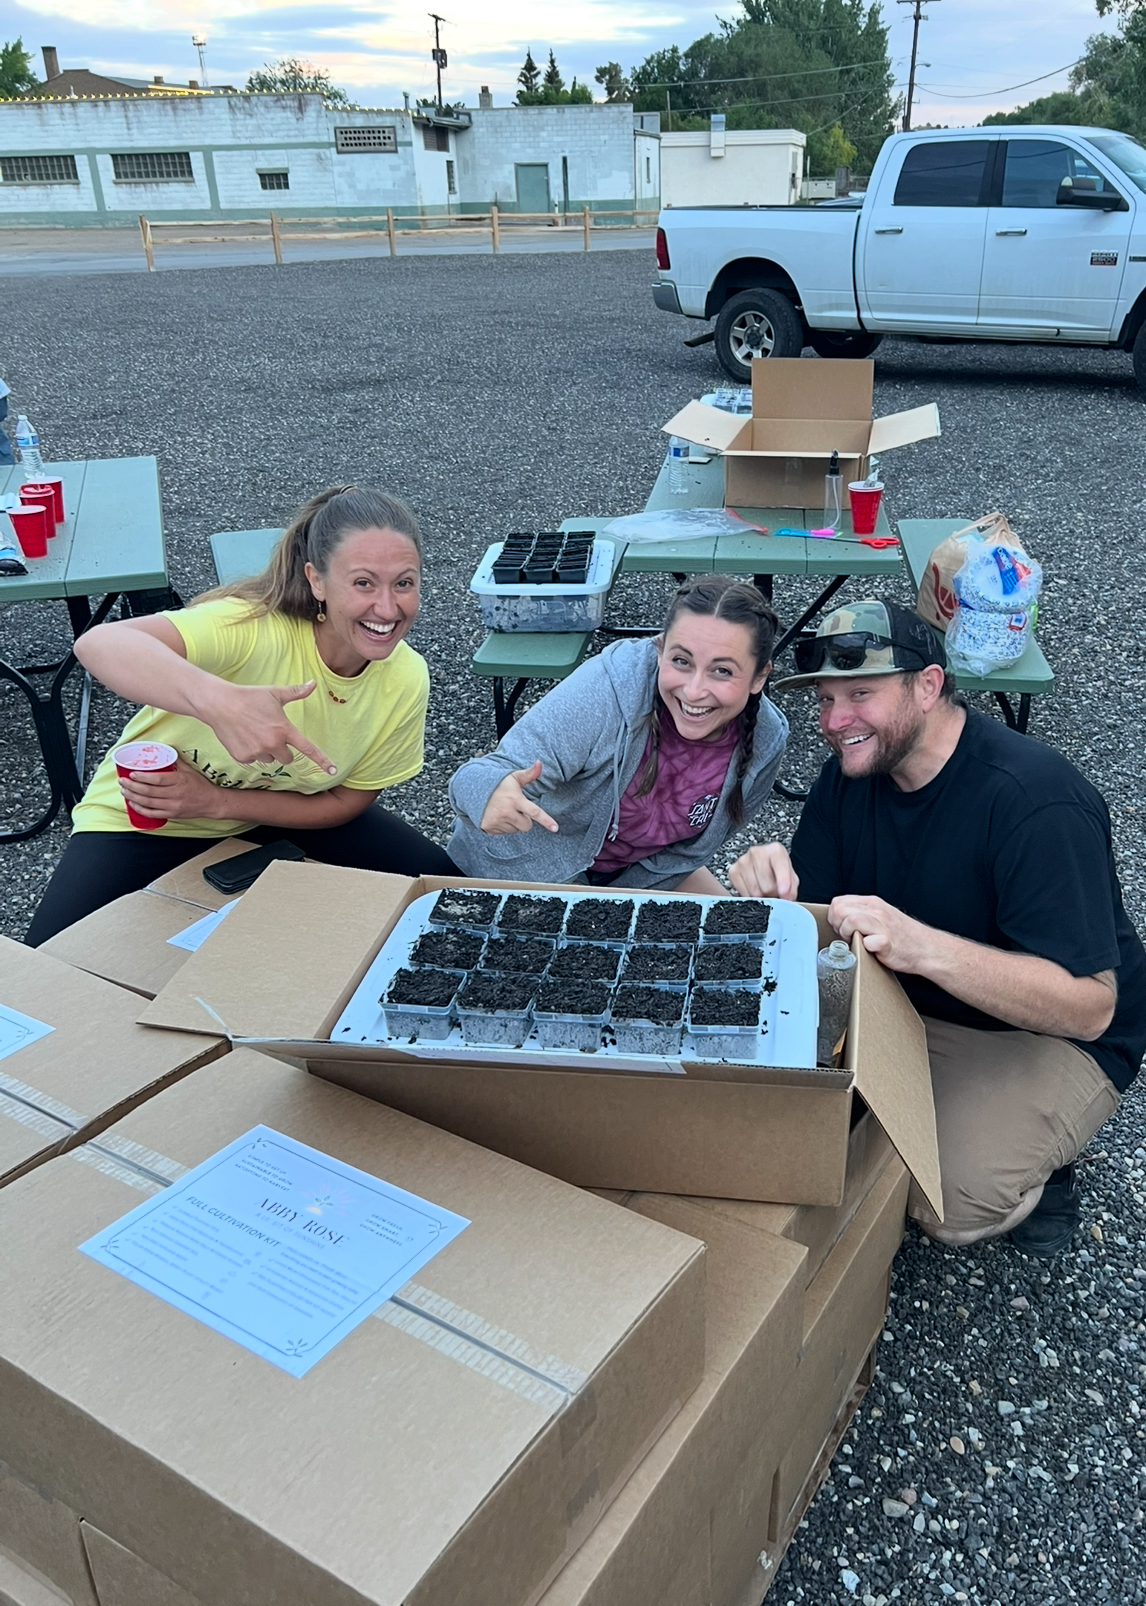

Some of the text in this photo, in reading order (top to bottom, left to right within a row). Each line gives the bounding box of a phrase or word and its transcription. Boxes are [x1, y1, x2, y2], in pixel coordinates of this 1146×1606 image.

[241, 1159, 272, 1176] SUSTAINABLE
[185, 1196, 208, 1210] FULL
[207, 1207, 266, 1240] CULTIVATION
[263, 1236, 282, 1248] KIT
[254, 1198, 350, 1248] ABBY ROSE
[365, 1218, 381, 1228] GROW
[371, 1213, 386, 1223] GROW
[359, 1223, 375, 1233] GROW
